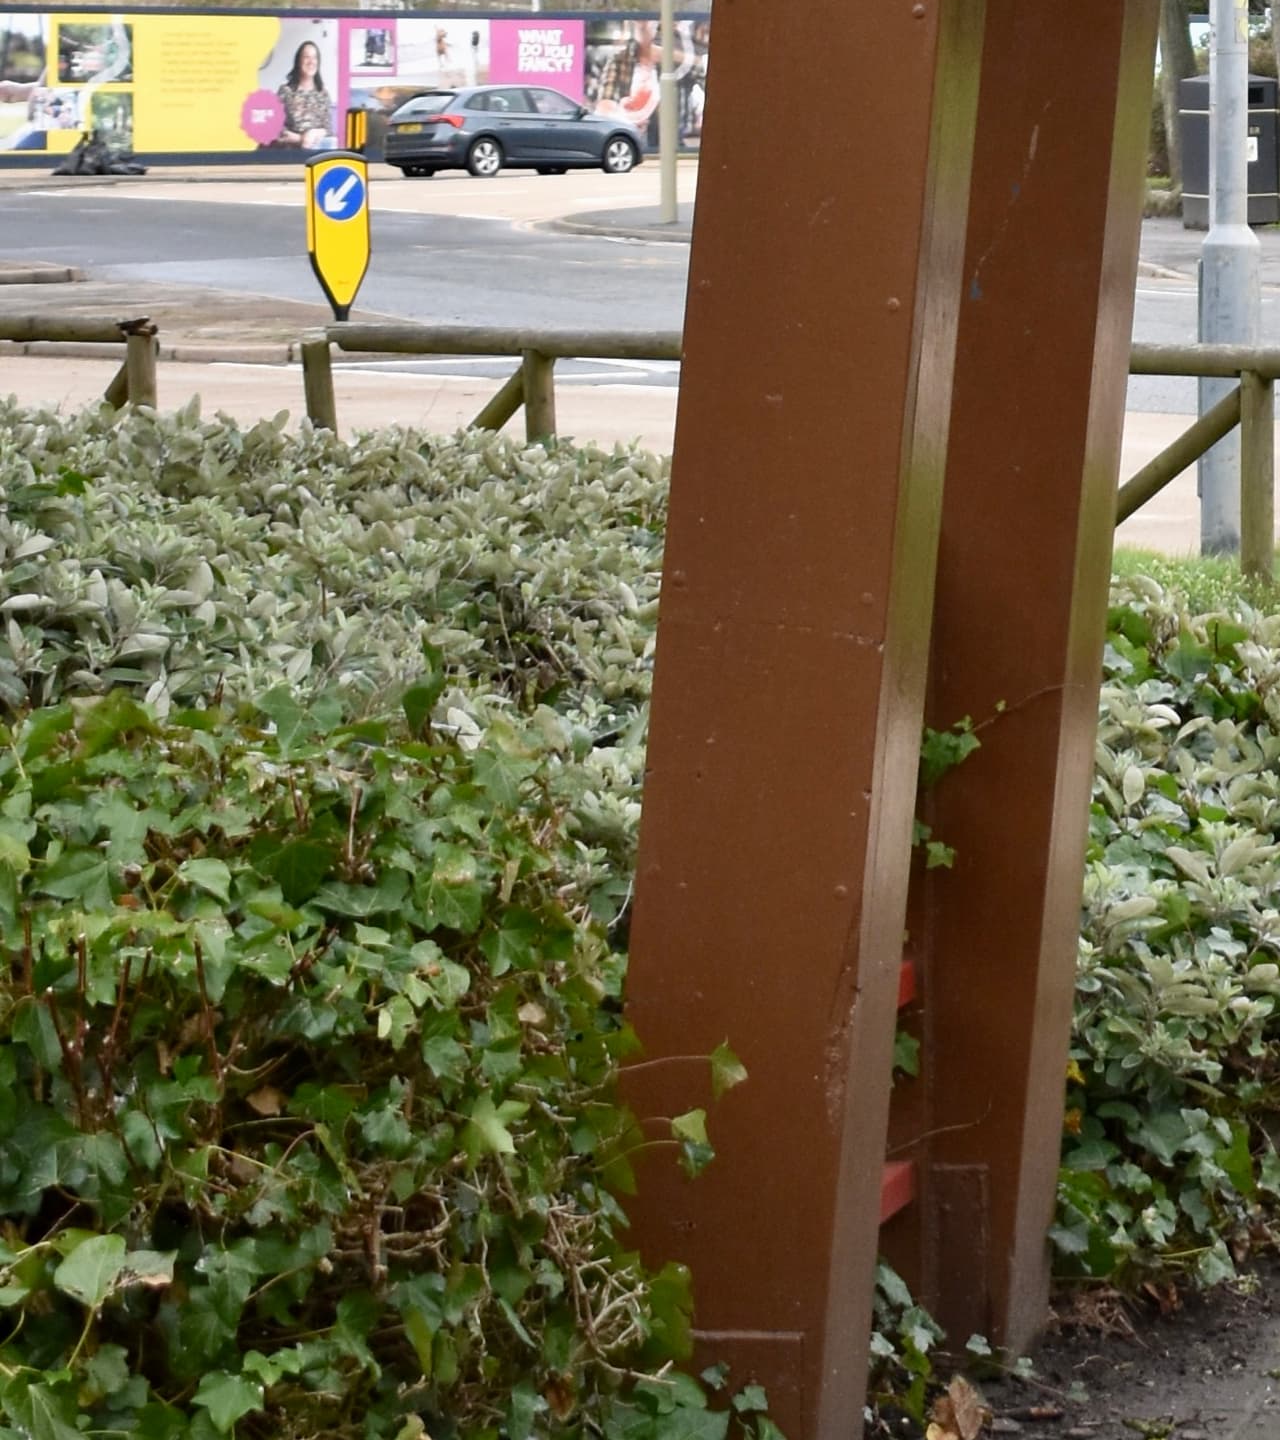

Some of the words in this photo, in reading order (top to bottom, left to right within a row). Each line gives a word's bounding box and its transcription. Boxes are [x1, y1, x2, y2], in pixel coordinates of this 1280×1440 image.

[518, 29, 563, 44] WHAT
[518, 43, 543, 57] DO
[544, 44, 575, 59] YOU
[518, 57, 573, 73] FANCY?
